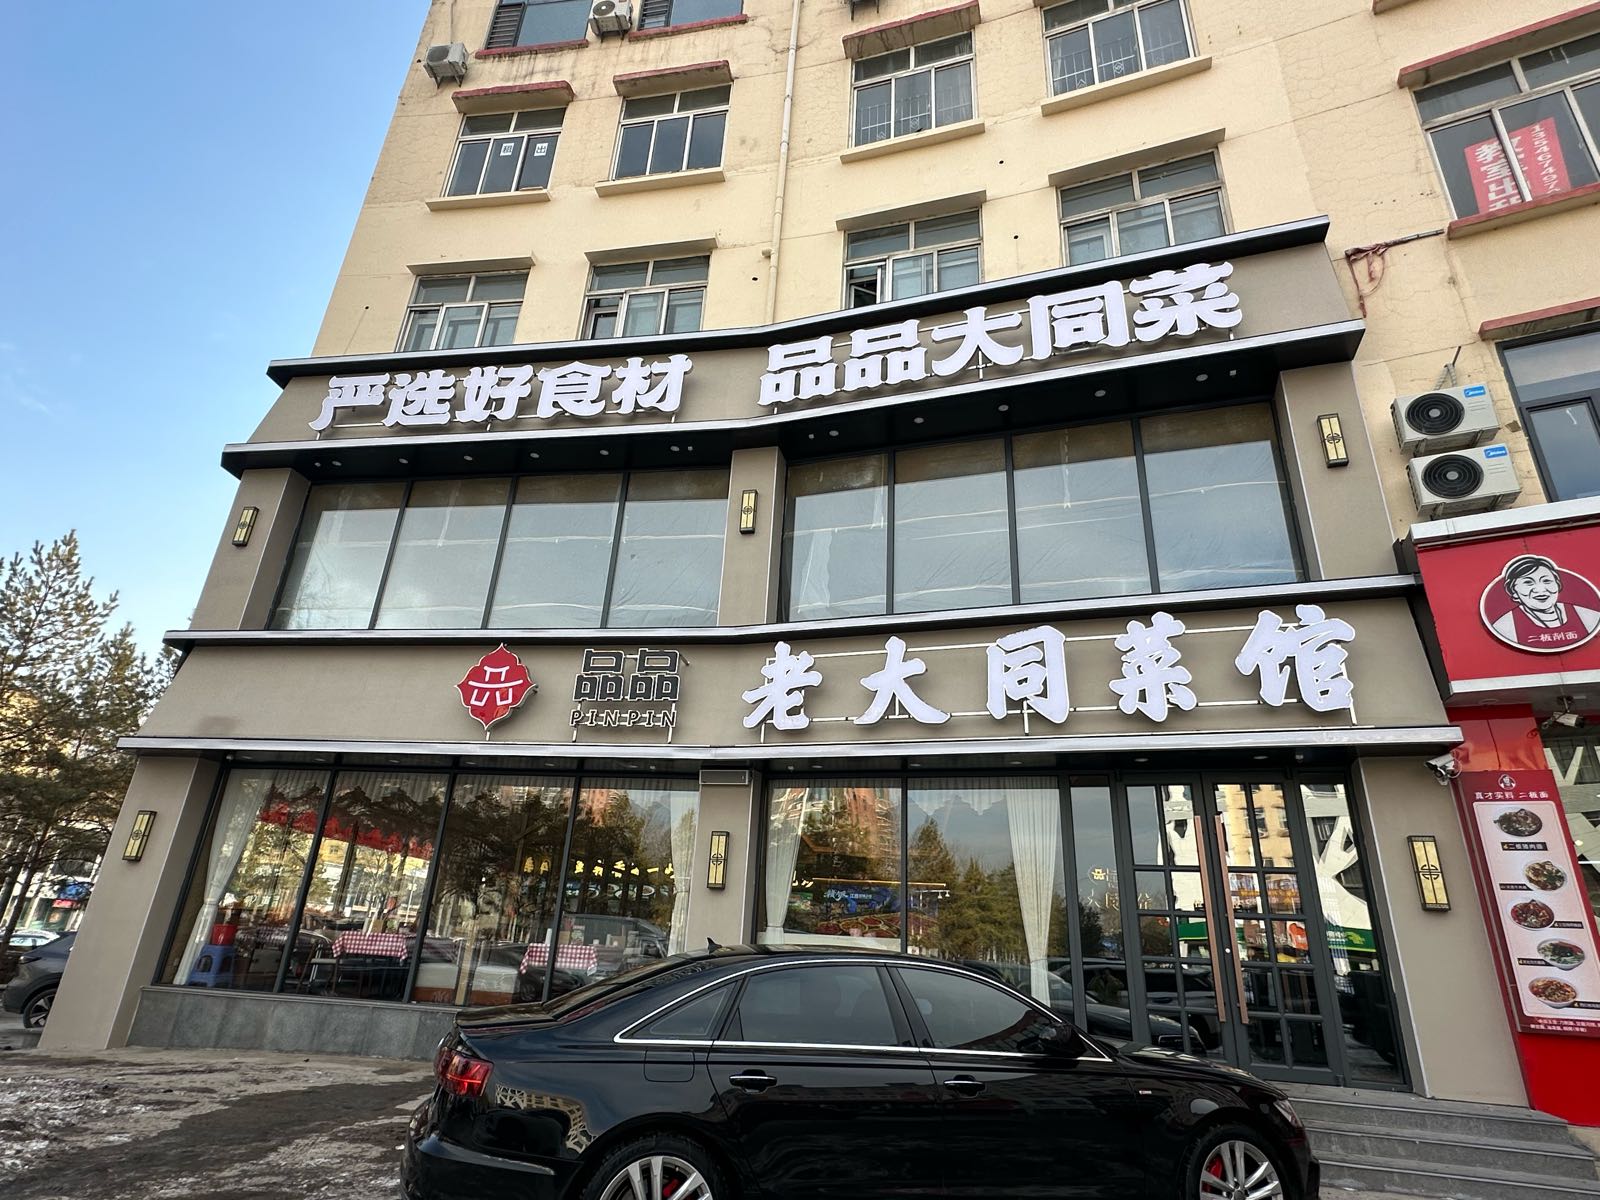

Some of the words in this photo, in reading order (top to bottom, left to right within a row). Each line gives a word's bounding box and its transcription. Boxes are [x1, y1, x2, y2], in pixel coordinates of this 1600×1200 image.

[308, 354, 693, 433] 严选好食材
[758, 261, 1243, 407] 品品大同菜
[1527, 630, 1578, 643] 二板削面
[573, 648, 681, 702] 品品
[741, 604, 1356, 731] 老大同菜馆
[570, 709, 677, 728] PINPIN
